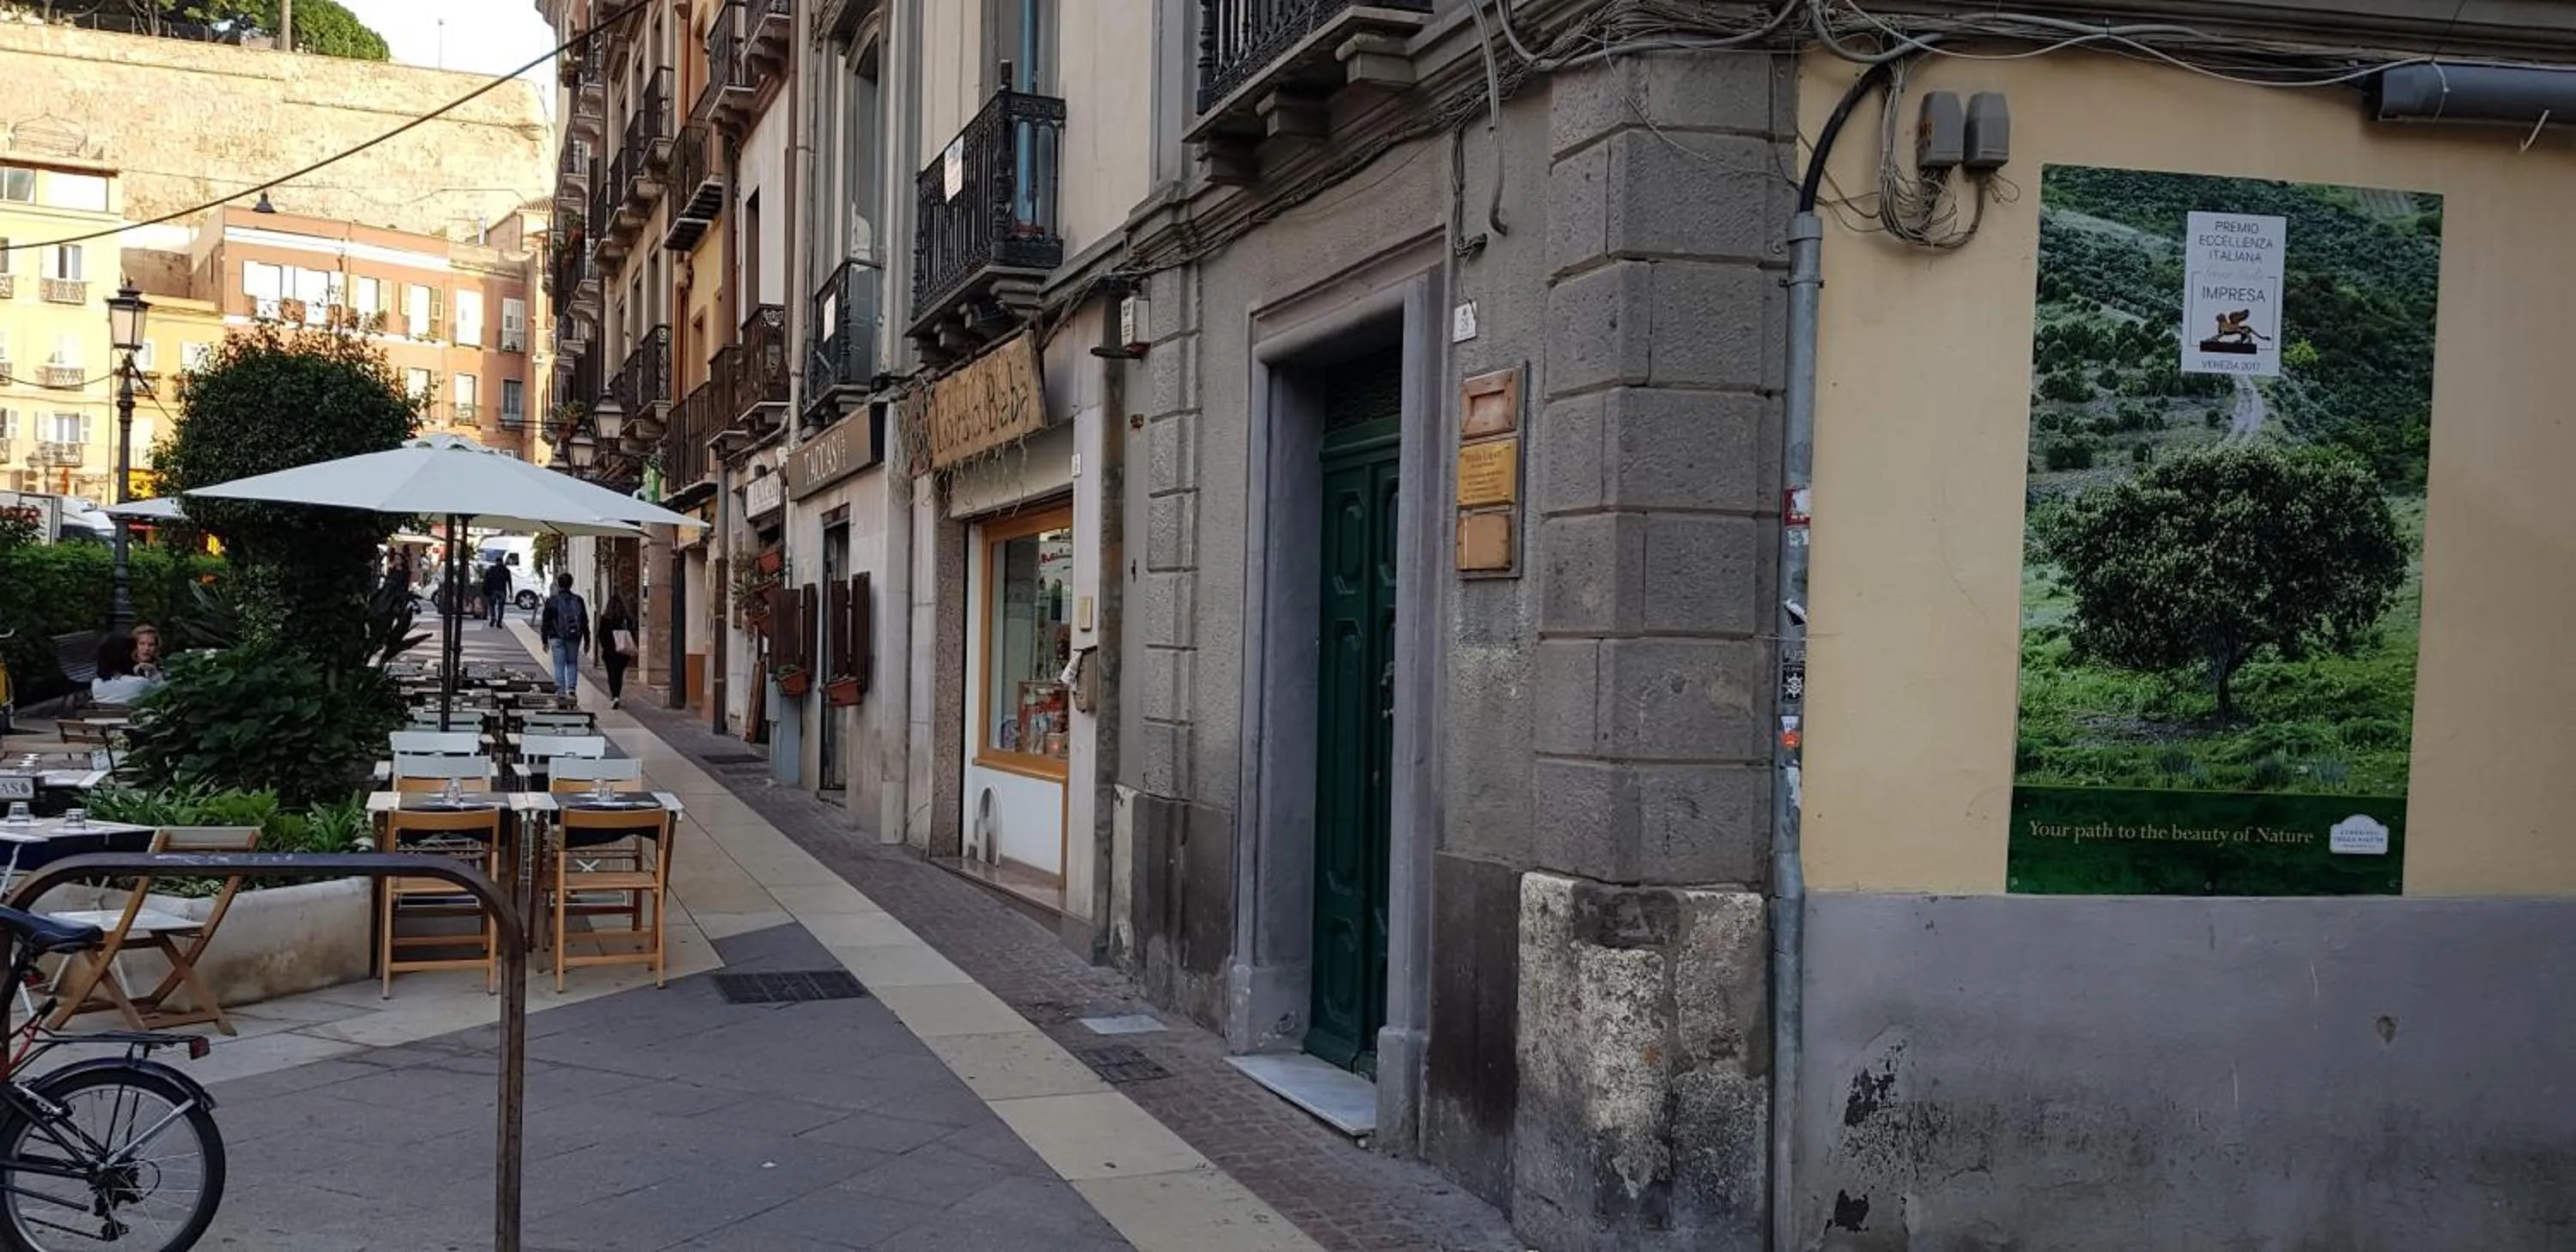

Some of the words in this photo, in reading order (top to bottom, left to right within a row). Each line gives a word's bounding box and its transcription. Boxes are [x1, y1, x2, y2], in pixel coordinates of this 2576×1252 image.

[2215, 221, 2259, 234] PREMIO
[2199, 234, 2273, 249] ECCELLENZA
[2209, 249, 2262, 263] ITALIANA
[2202, 286, 2266, 302] IMPRESA
[2030, 820, 2070, 837] Your
[2075, 822, 2112, 844] path
[2117, 824, 2136, 839] to
[2141, 824, 2167, 840] the
[2172, 824, 2229, 848] beauty
[2233, 825, 2254, 842] of
[2255, 827, 2314, 843] Nature
